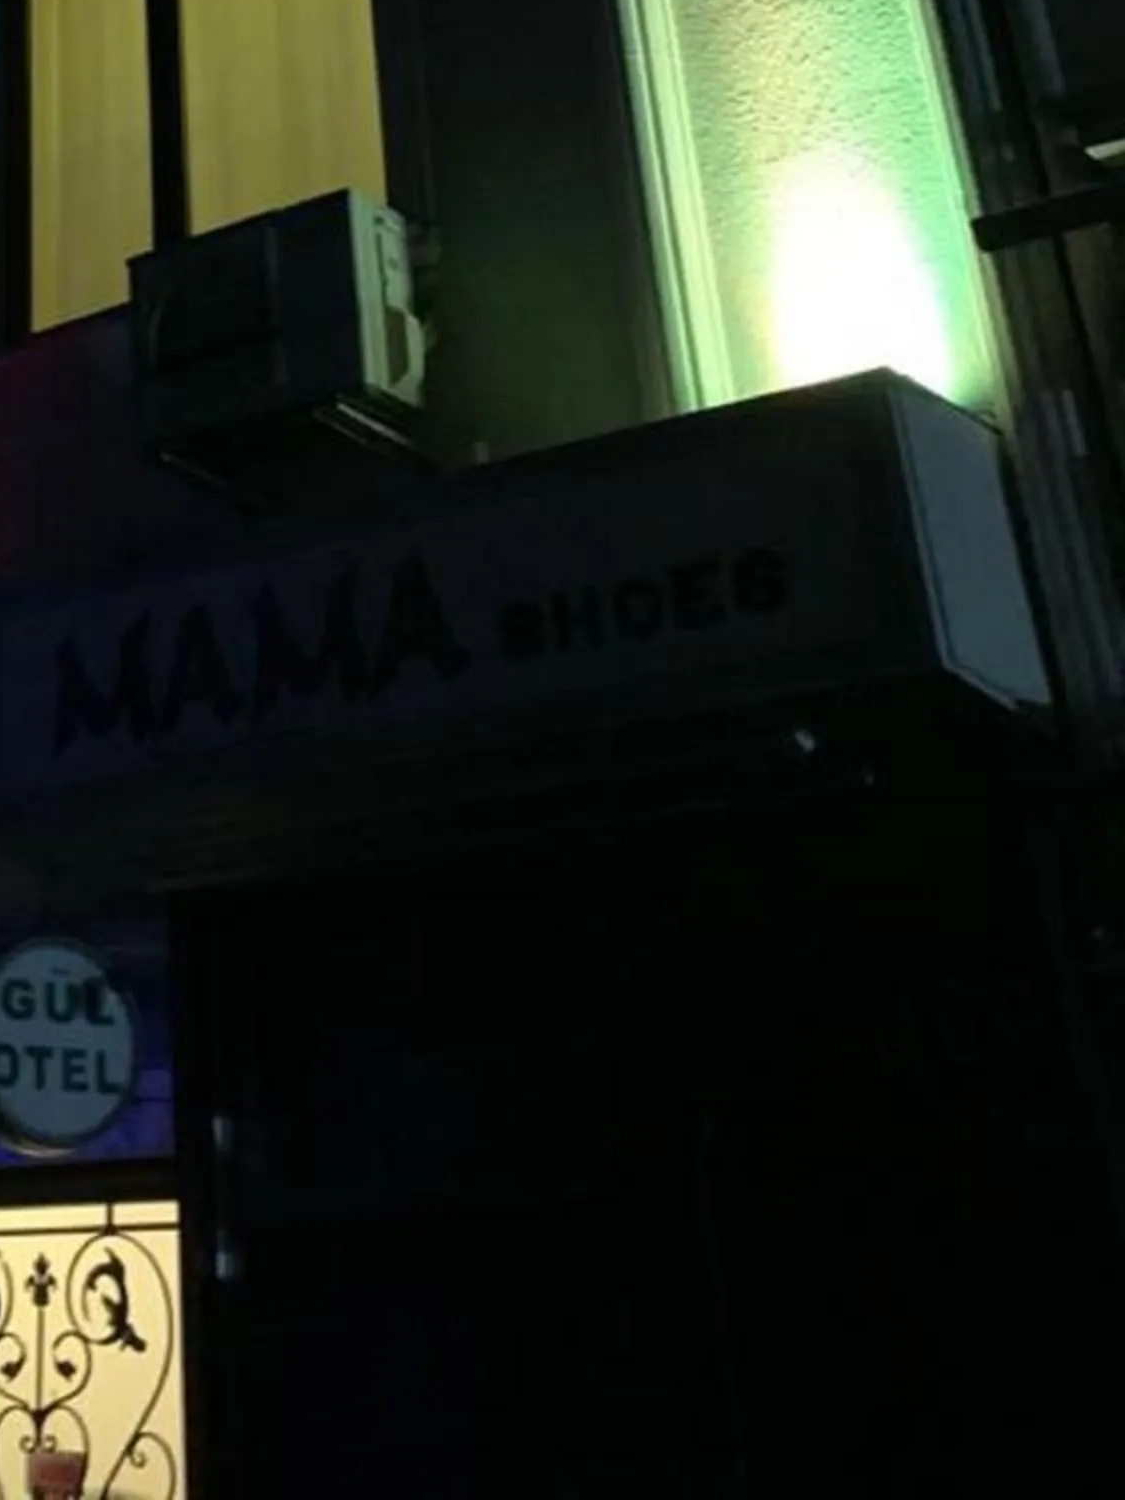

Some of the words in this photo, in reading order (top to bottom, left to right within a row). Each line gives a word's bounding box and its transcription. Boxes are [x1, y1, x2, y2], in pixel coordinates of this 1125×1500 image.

[53, 552, 473, 760] MAMA
[495, 547, 788, 661] SHOES
[1, 968, 116, 1026] GÜL
